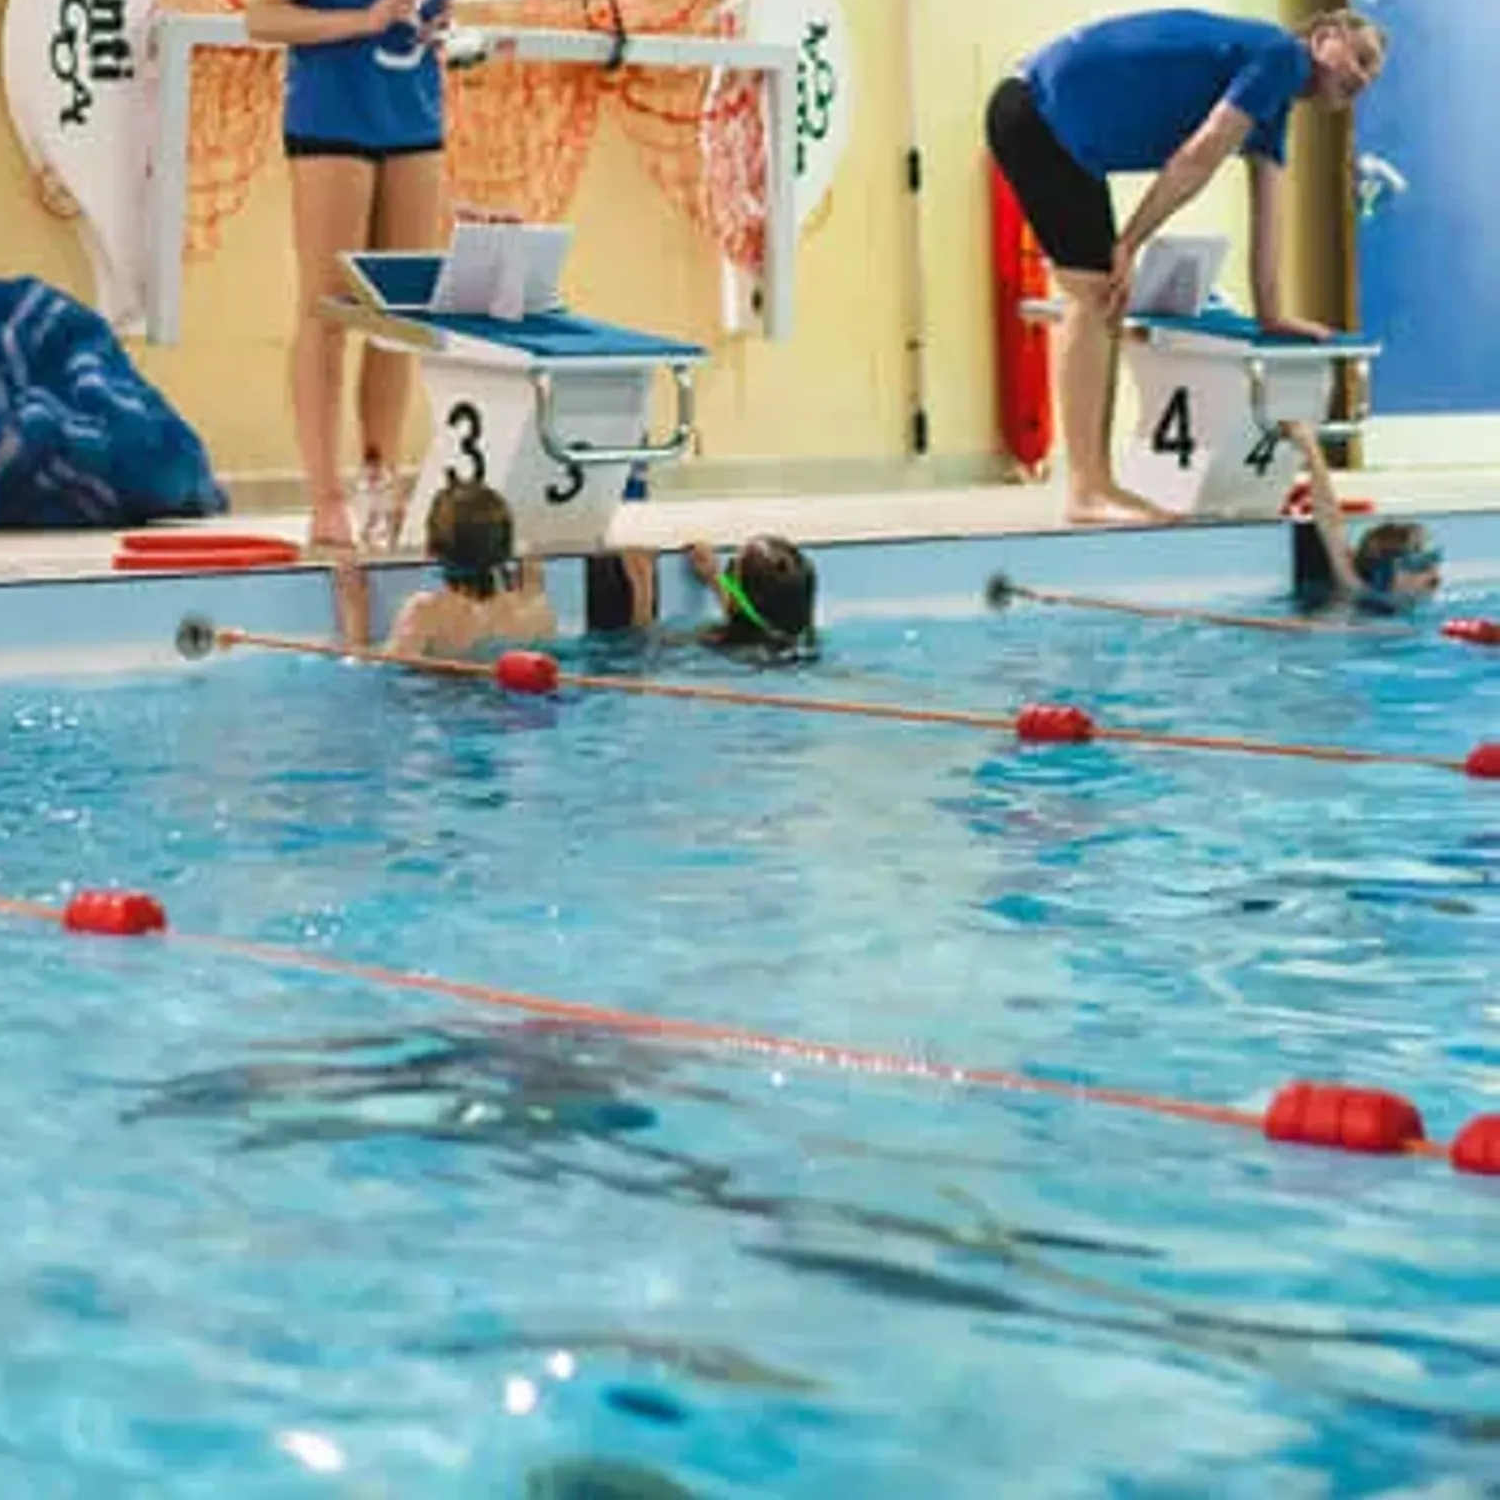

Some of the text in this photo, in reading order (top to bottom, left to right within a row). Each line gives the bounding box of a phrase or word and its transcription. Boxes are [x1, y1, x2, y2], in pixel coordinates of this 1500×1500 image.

[446, 401, 485, 486] 3
[1152, 385, 1195, 468] 4
[1243, 428, 1283, 477] 4
